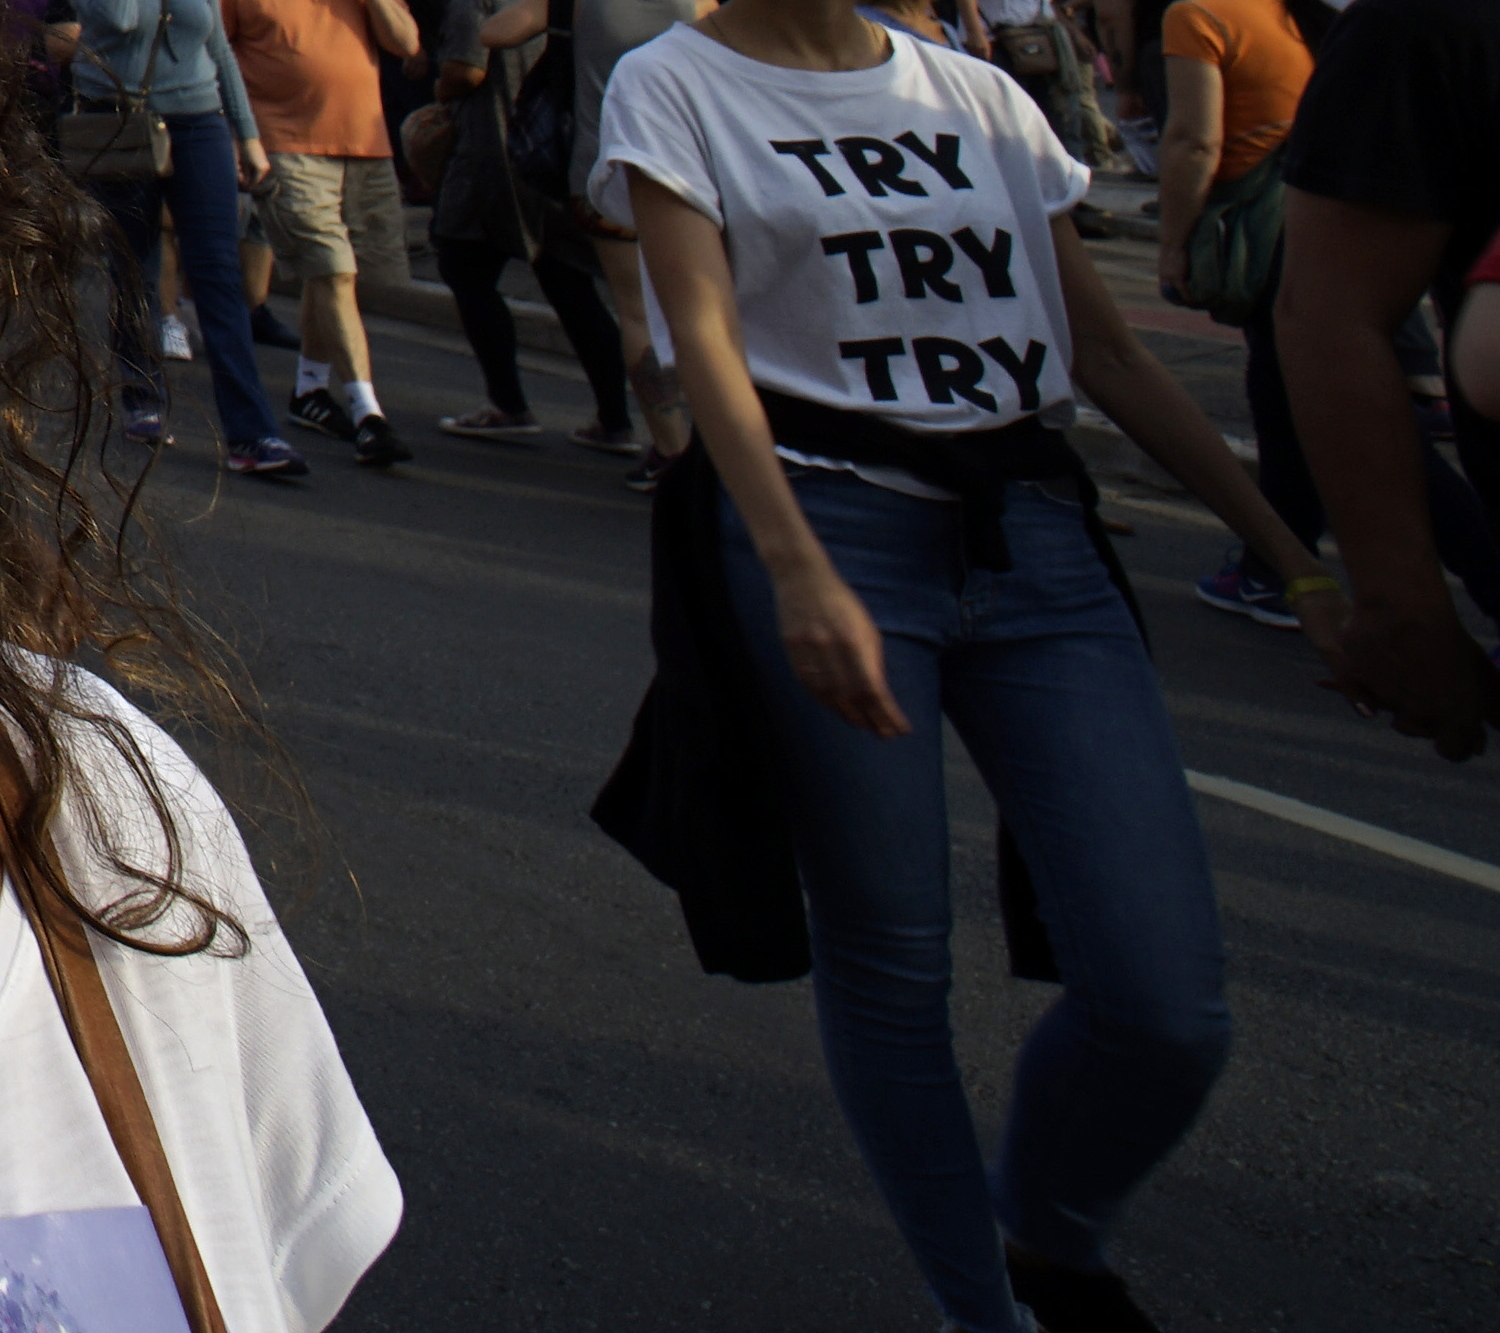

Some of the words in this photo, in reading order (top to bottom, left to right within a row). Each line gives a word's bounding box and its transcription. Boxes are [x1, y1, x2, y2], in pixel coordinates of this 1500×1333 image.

[769, 130, 974, 197] TRY
[819, 226, 1017, 305] TRY
[838, 336, 1047, 414] TRY
